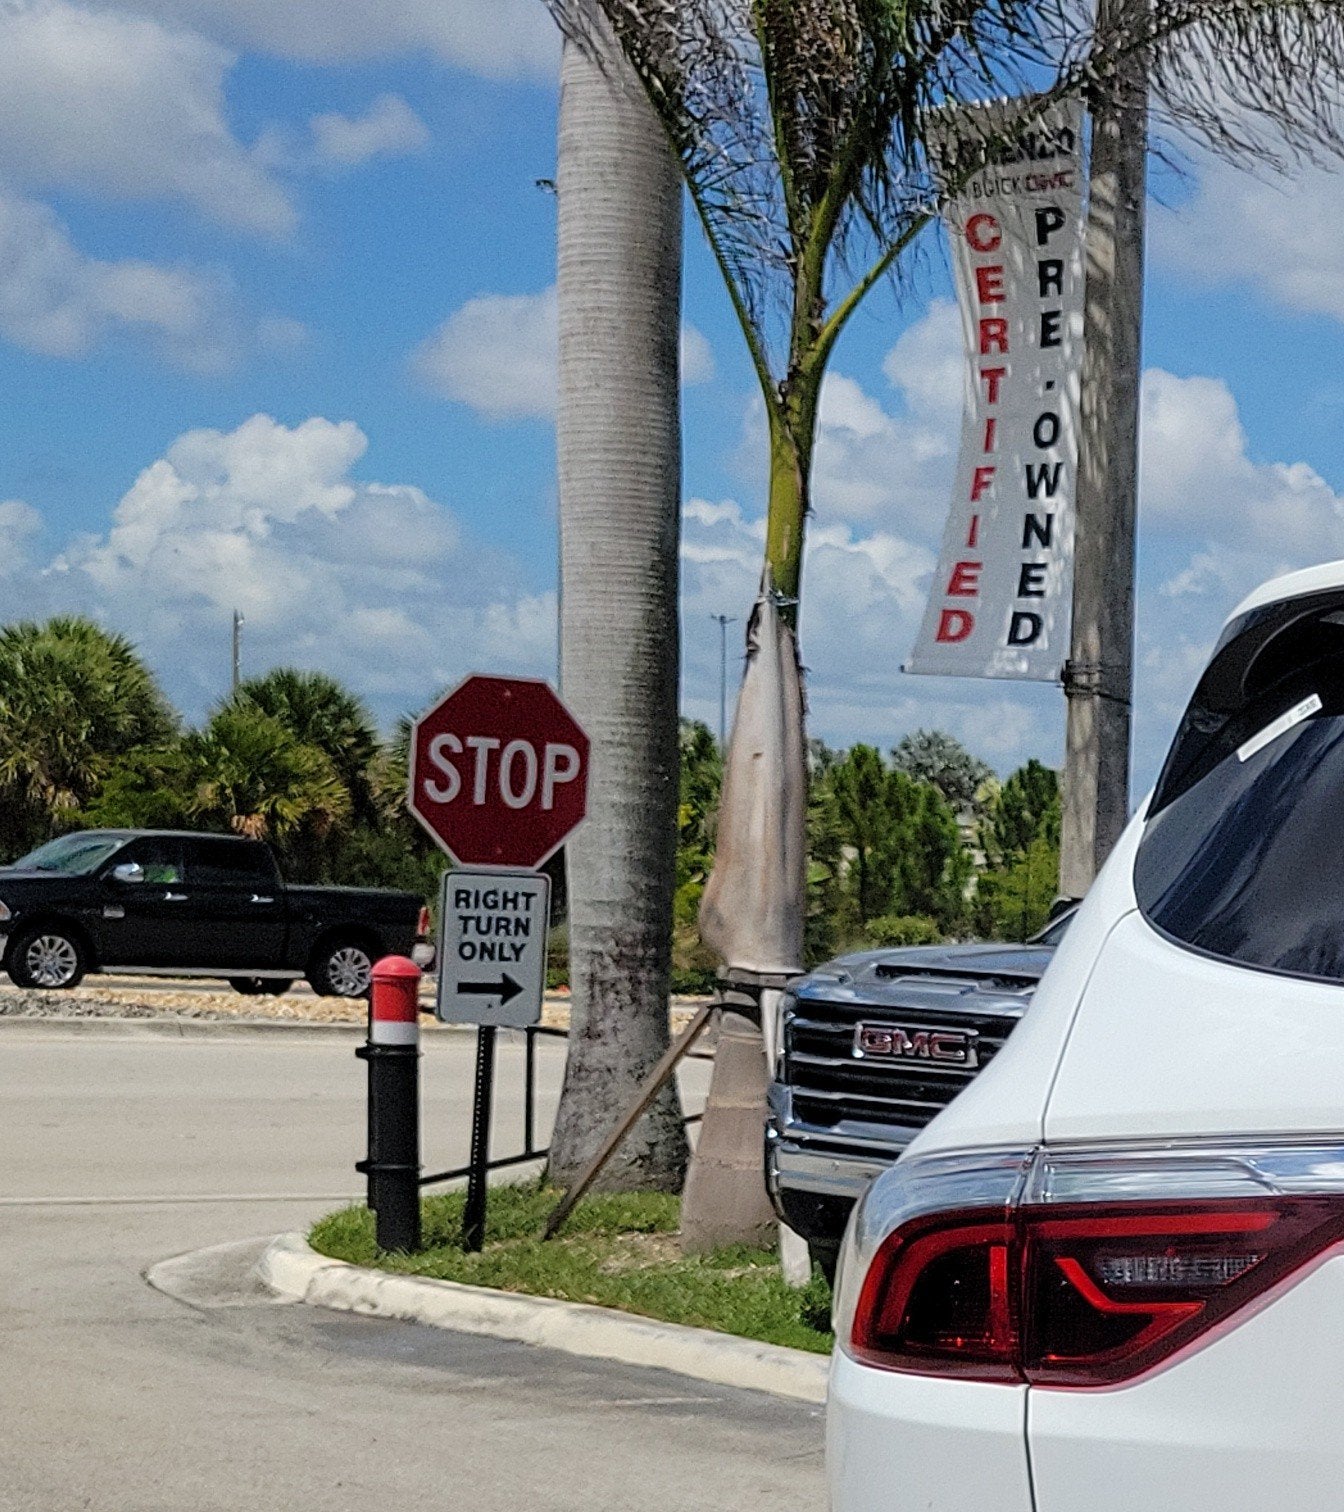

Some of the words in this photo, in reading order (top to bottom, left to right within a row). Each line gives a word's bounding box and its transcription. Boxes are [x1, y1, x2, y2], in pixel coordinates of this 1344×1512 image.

[935, 212, 1009, 643] CERTIFIED
[423, 732, 581, 811] STOP
[455, 888, 538, 912] RIGHT
[458, 915, 532, 937] TURN
[458, 942, 527, 963] ONLY
[861, 1026, 966, 1061] GMC
